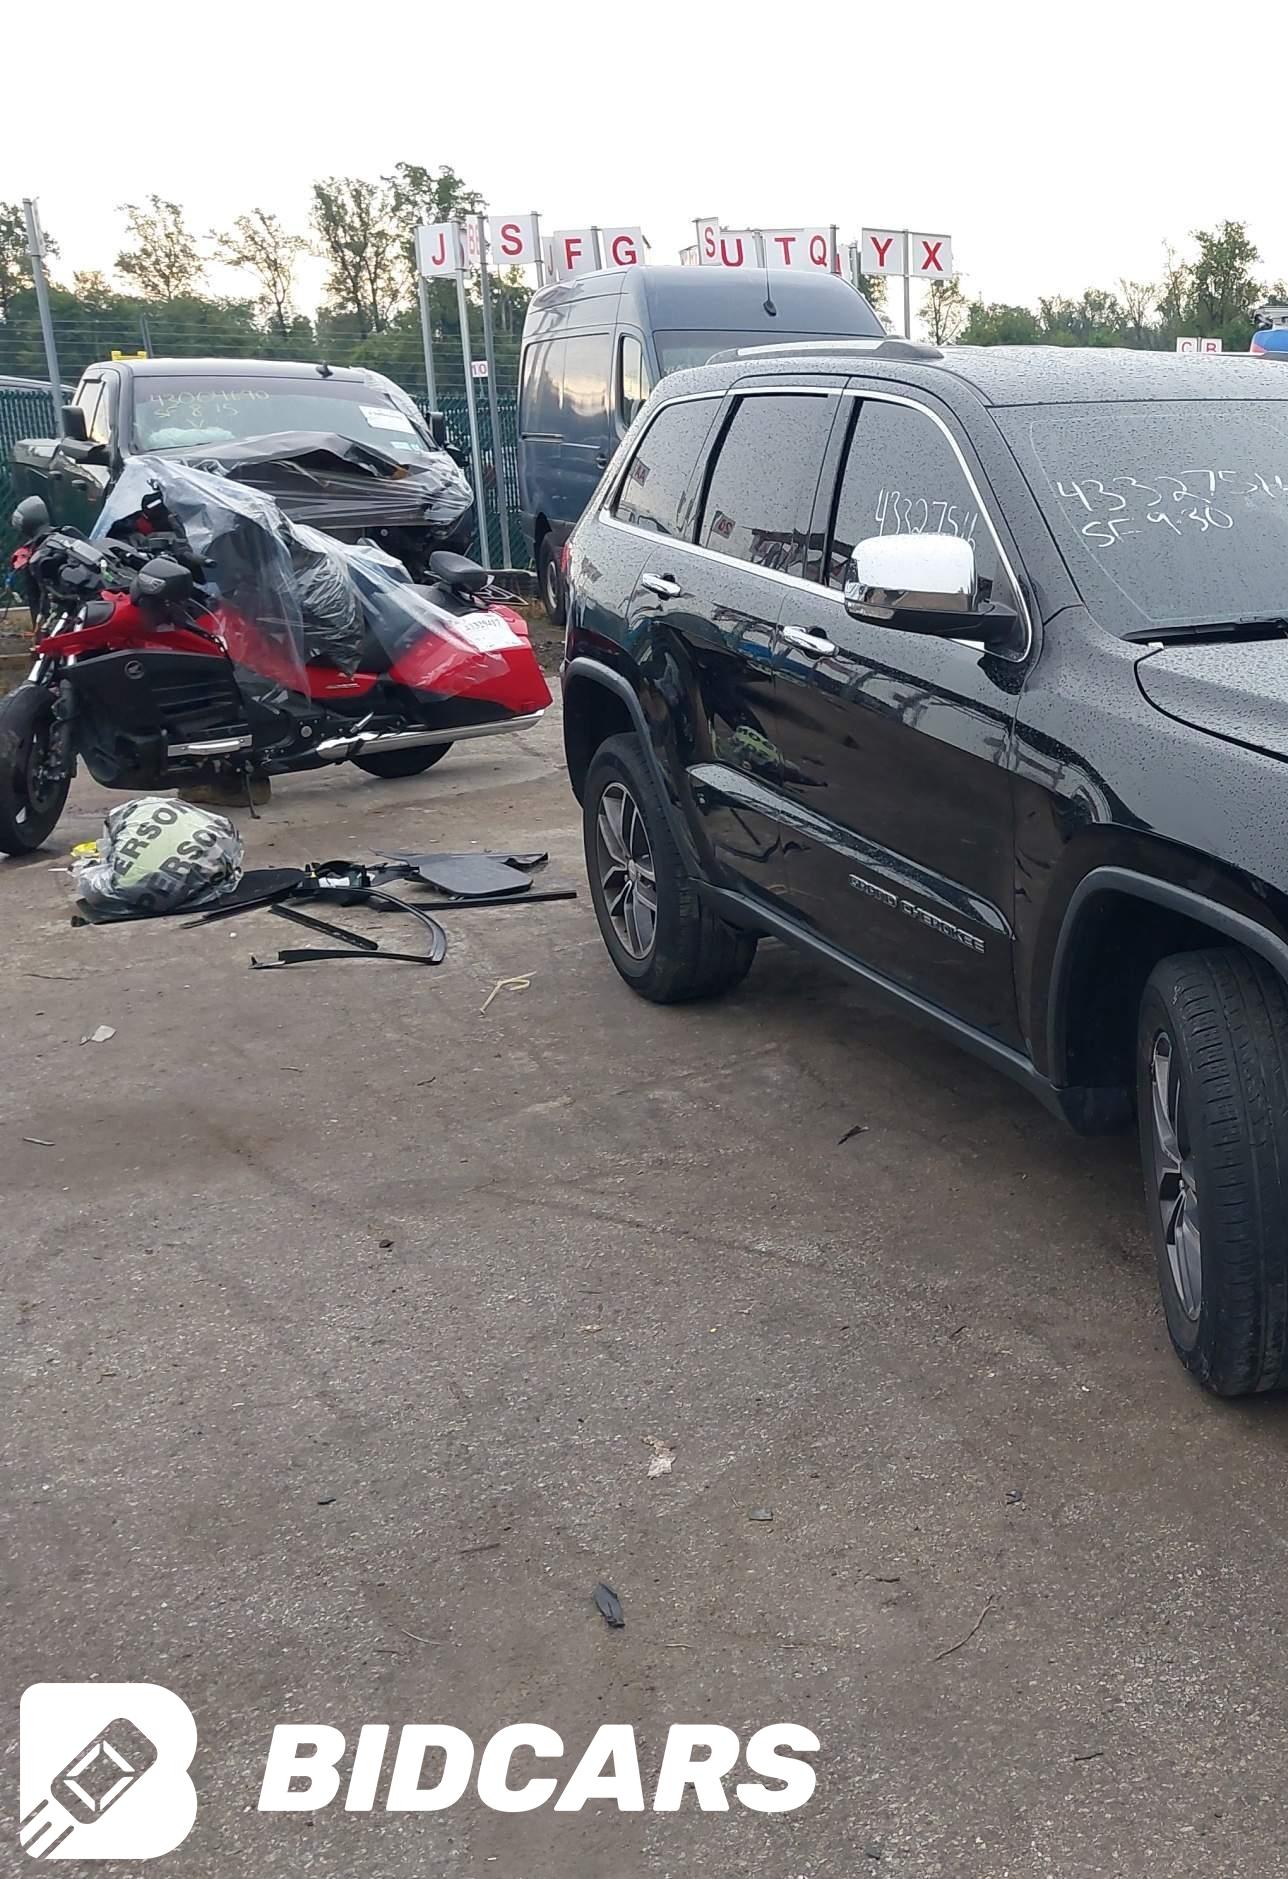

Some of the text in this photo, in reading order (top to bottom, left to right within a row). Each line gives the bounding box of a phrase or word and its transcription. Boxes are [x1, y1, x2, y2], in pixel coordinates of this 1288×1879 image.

[431, 233, 445, 266] J
[501, 223, 524, 256] S
[564, 238, 583, 270] F
[611, 235, 638, 266] G
[704, 226, 715, 258] S
[720, 238, 744, 267] U
[774, 236, 796, 265] T
[809, 235, 827, 267] Q
[871, 236, 894, 267] Y
[921, 241, 943, 271] X
